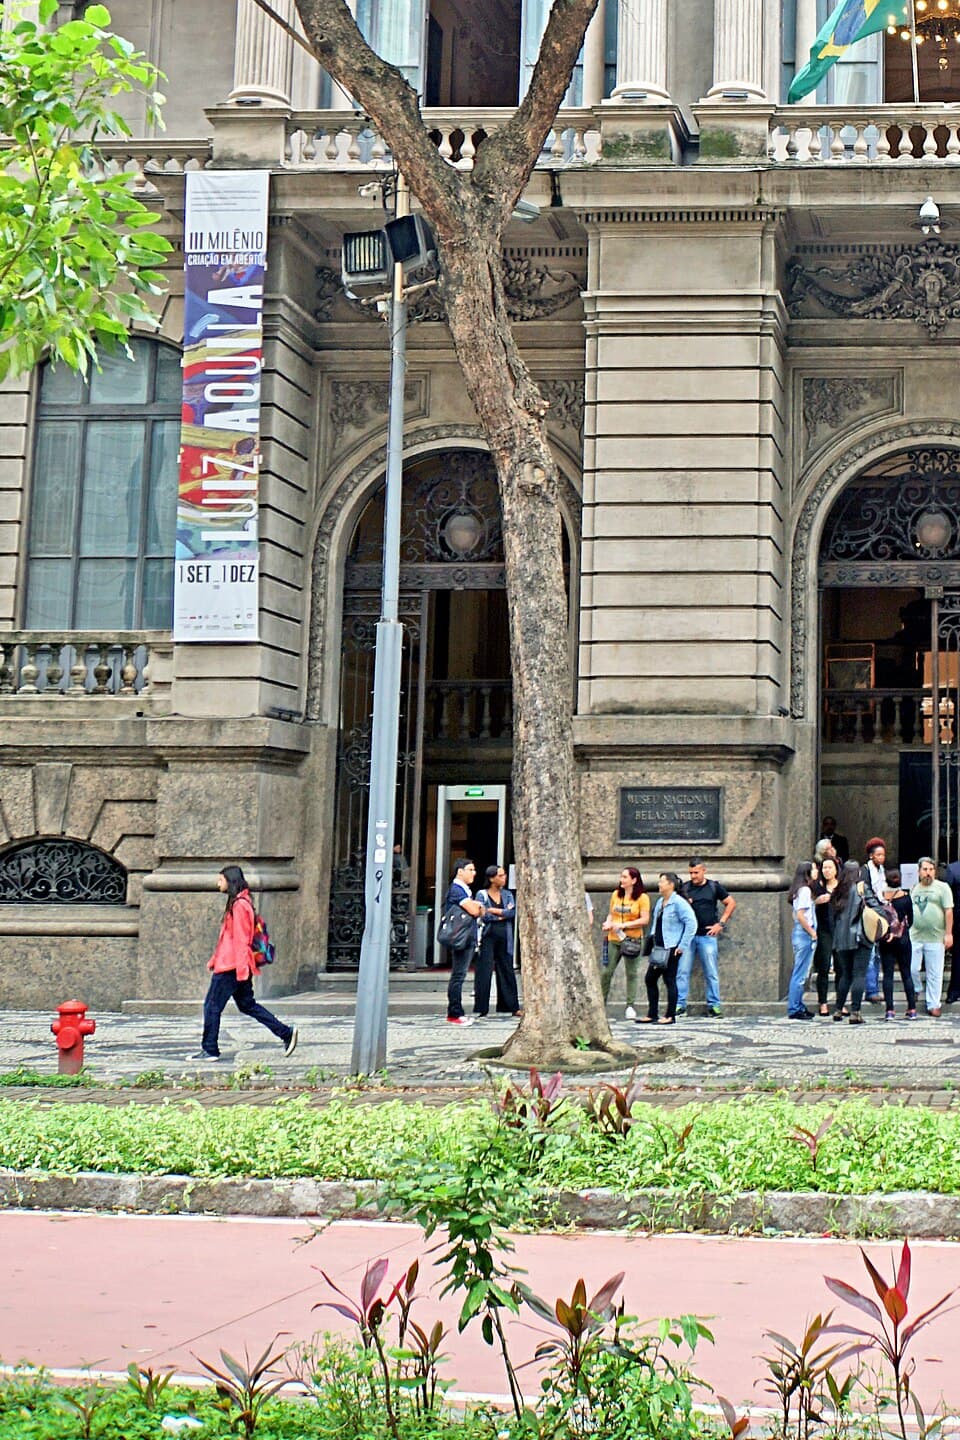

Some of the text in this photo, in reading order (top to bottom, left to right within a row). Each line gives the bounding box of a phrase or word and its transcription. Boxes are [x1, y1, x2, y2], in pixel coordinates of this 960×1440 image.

[207, 228, 263, 250] MILÊNIO
[187, 252, 263, 268] CRIAÇÃO EM ABERTO
[200, 455, 260, 542] LUIZ
[187, 564, 212, 583] SET
[230, 564, 255, 583] DEZ
[626, 794, 714, 805] MUSEU NACIONAL
[635, 810, 706, 820] BELAS ARTES
